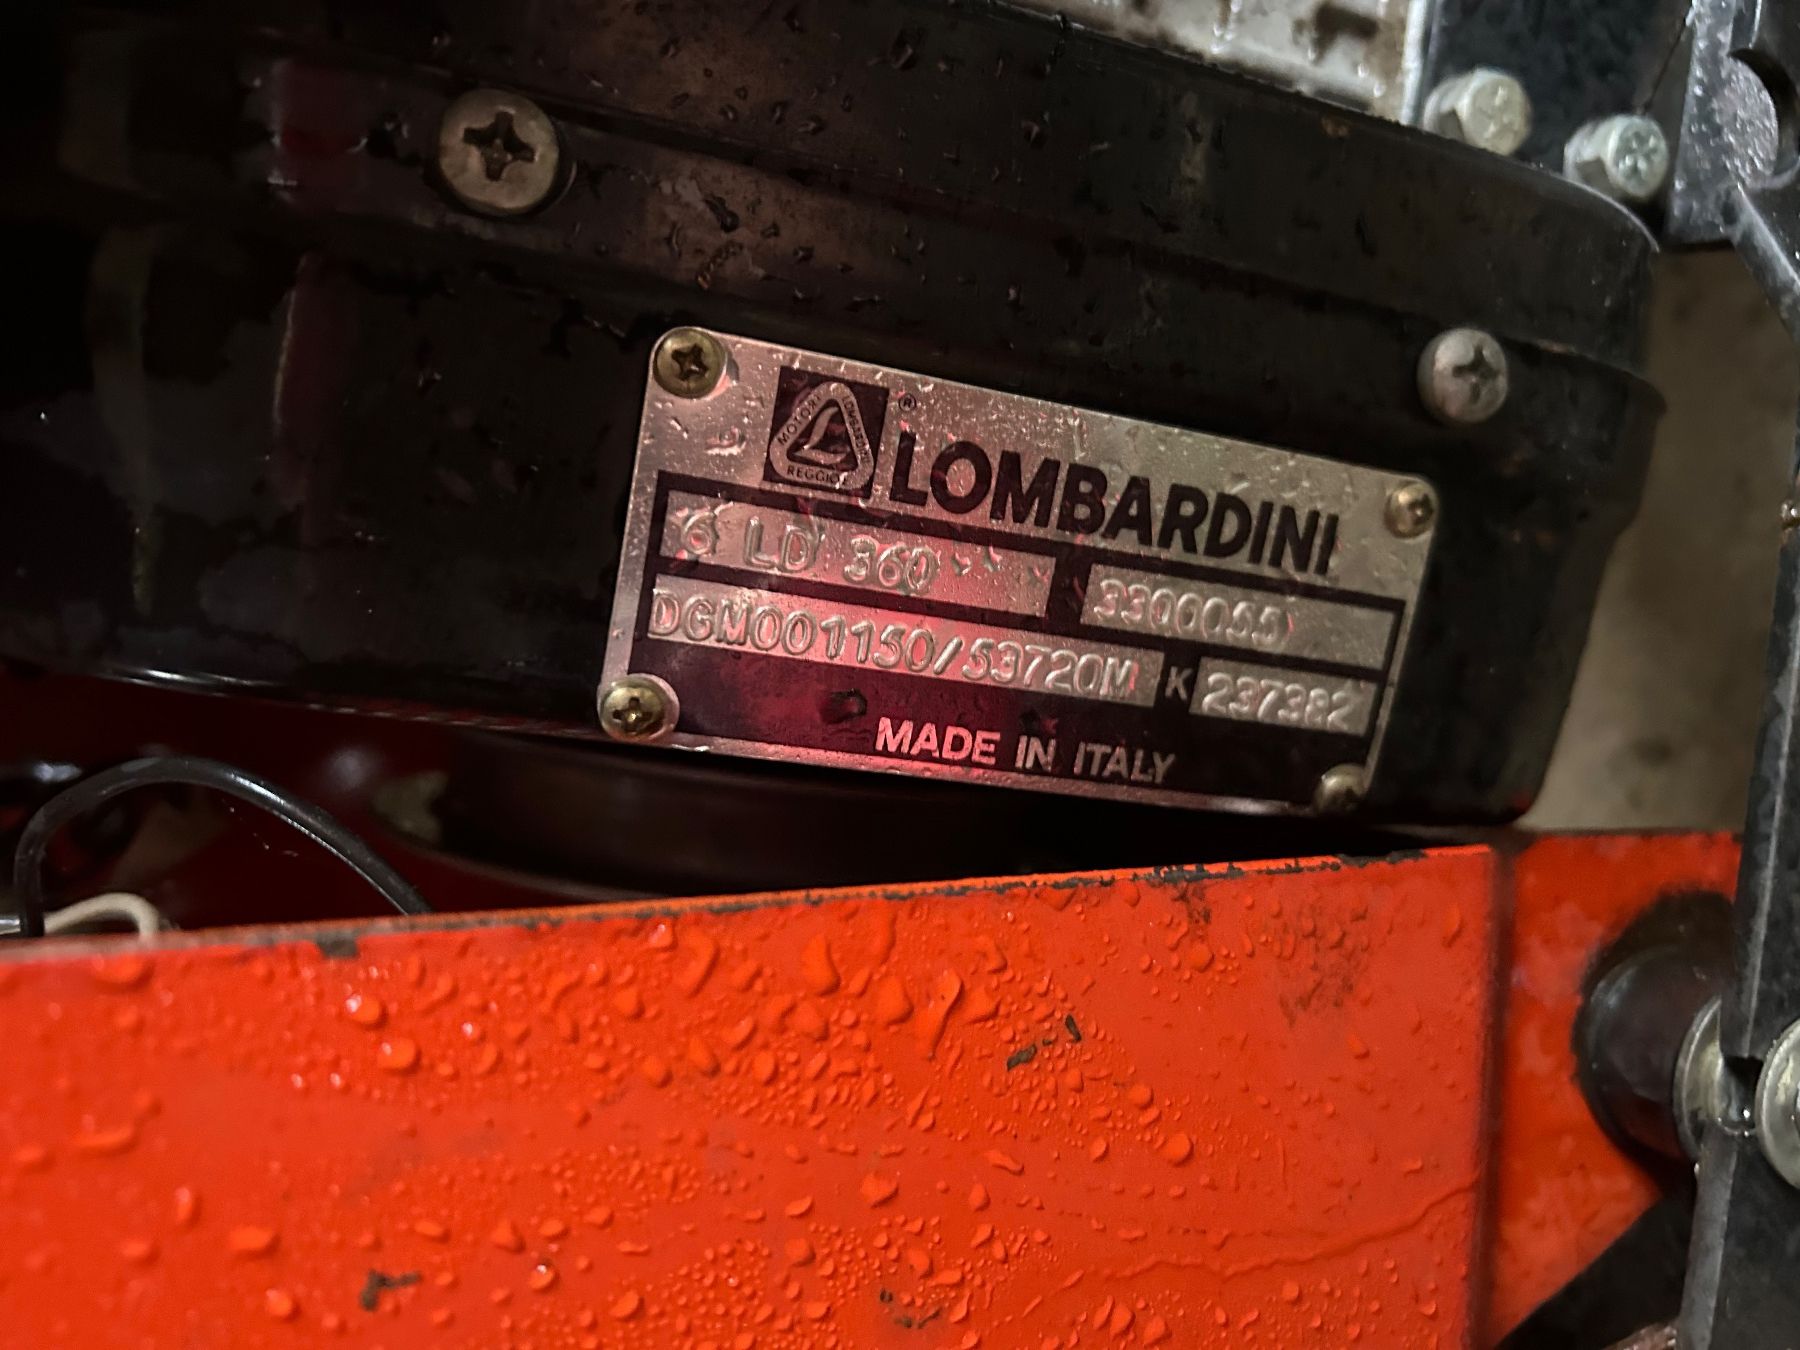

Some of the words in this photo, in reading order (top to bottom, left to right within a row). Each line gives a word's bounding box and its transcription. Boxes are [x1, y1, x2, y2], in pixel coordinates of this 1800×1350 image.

[890, 430, 1340, 577] LOMBARDINI
[680, 510, 718, 556] 6
[743, 515, 824, 573] LD
[843, 534, 939, 593] 360
[1164, 665, 1194, 701] K
[1200, 671, 1353, 731] 237382
[874, 716, 1001, 766] MADE
[1015, 735, 1057, 774] IN
[1073, 742, 1178, 785] ITALY
